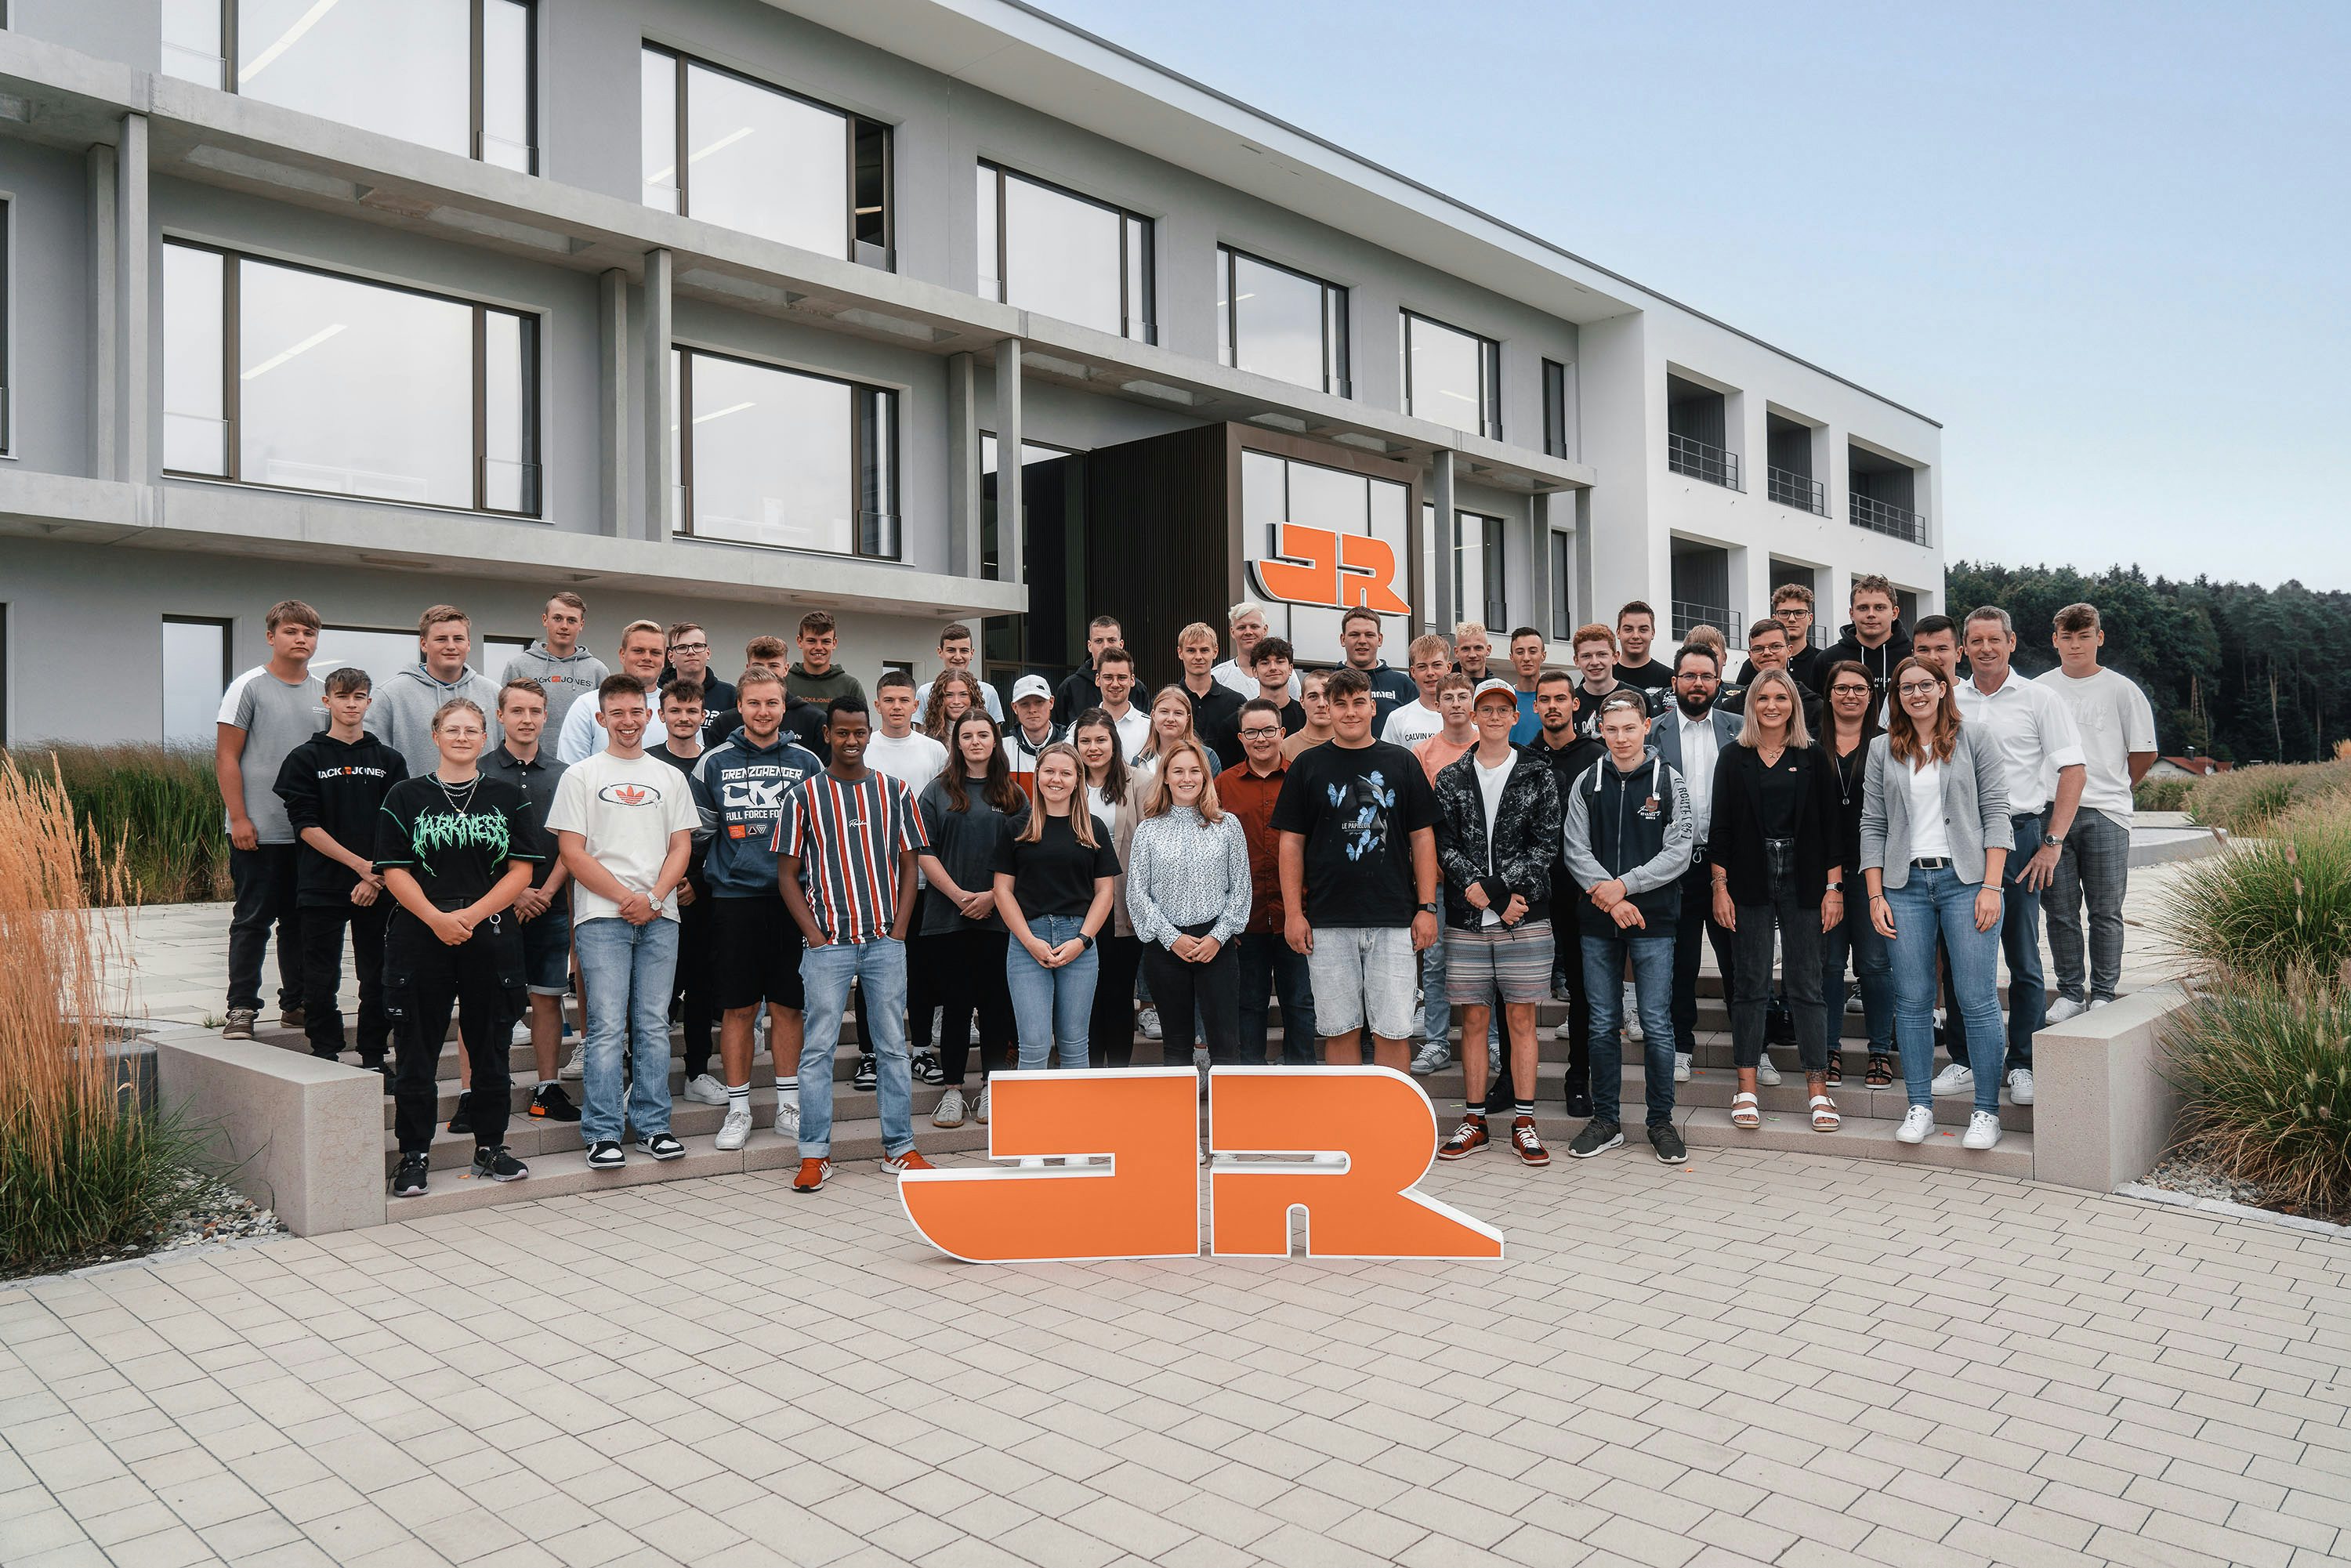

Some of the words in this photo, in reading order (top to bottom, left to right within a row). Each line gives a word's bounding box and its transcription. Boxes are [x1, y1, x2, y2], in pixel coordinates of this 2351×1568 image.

[561, 676, 591, 686] JONES
[351, 766, 384, 778] JONES
[721, 766, 803, 780] GRENZGAENGER
[1678, 787, 1692, 815] ROUTE
[726, 811, 743, 821] FULL
[744, 809, 768, 820] FORCE
[770, 809, 781, 818] FO
